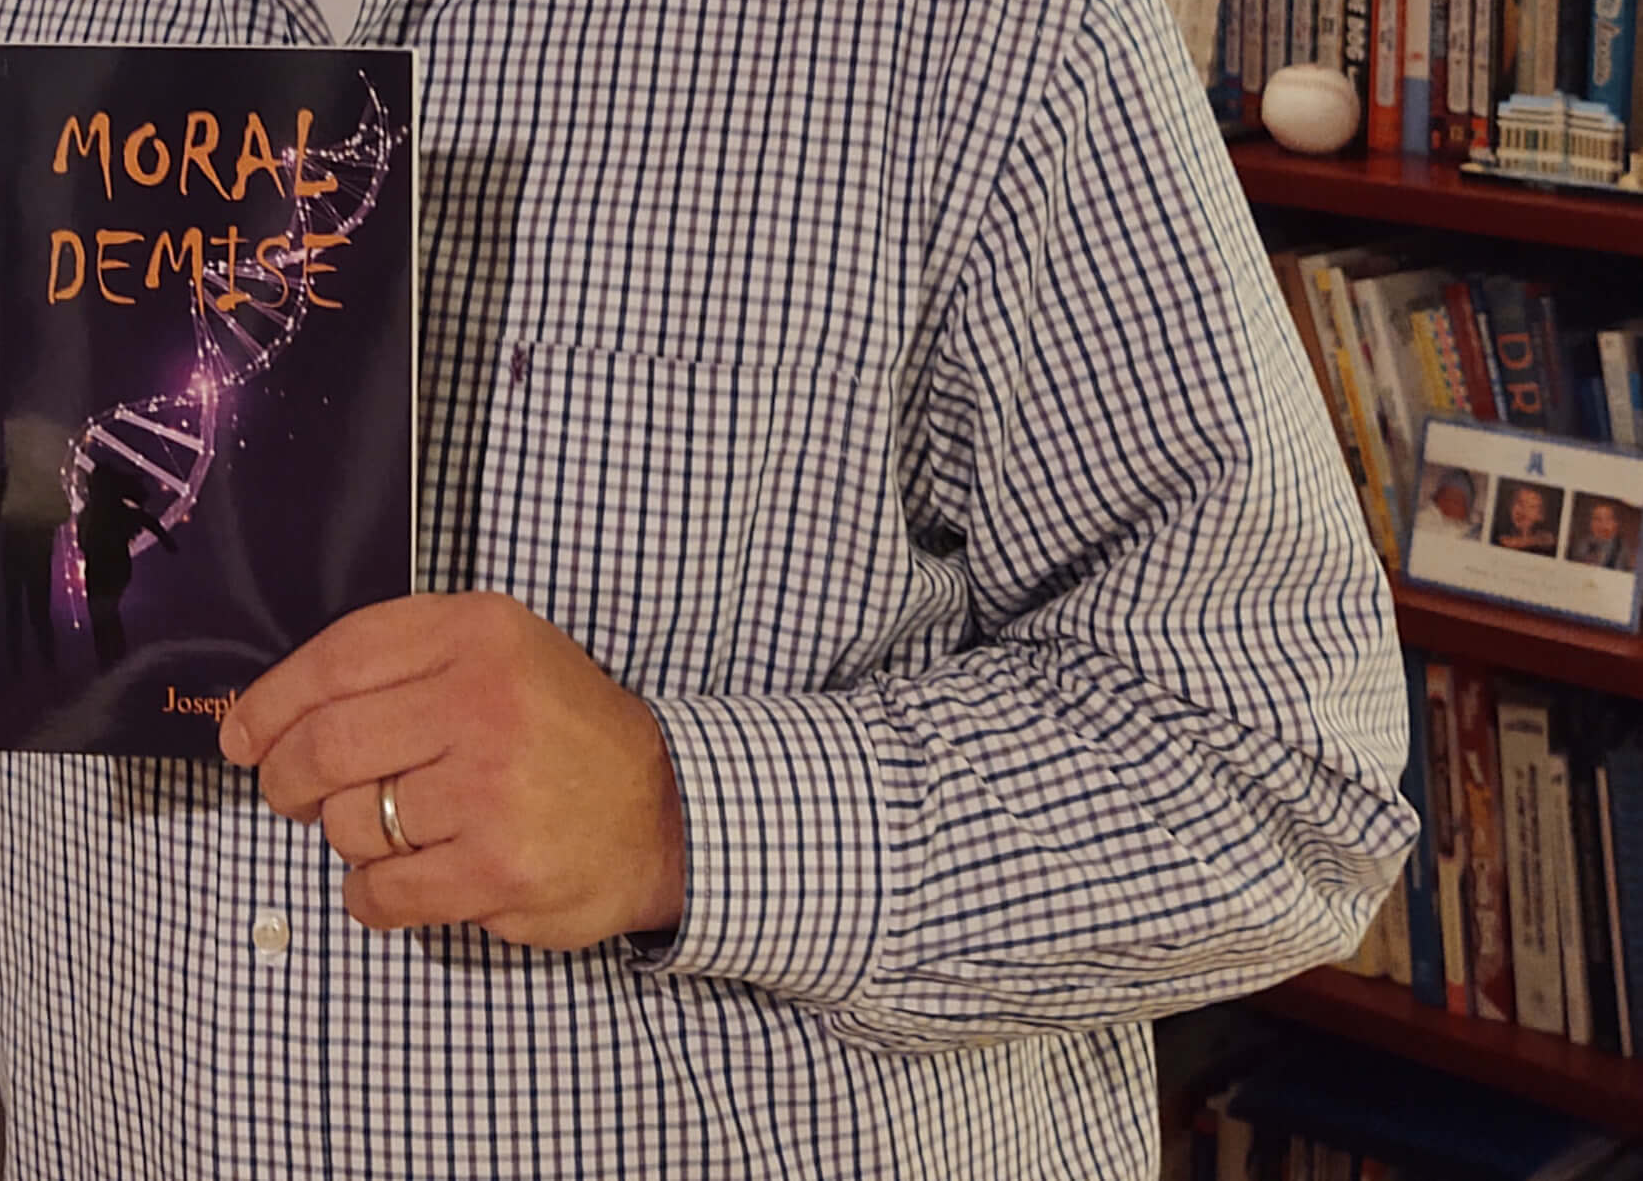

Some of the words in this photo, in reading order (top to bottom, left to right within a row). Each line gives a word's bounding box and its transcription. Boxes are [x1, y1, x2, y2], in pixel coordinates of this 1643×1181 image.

[1343, 18, 1366, 62] DOG
[52, 108, 339, 201] MORAL
[48, 225, 351, 313] DEMISE
